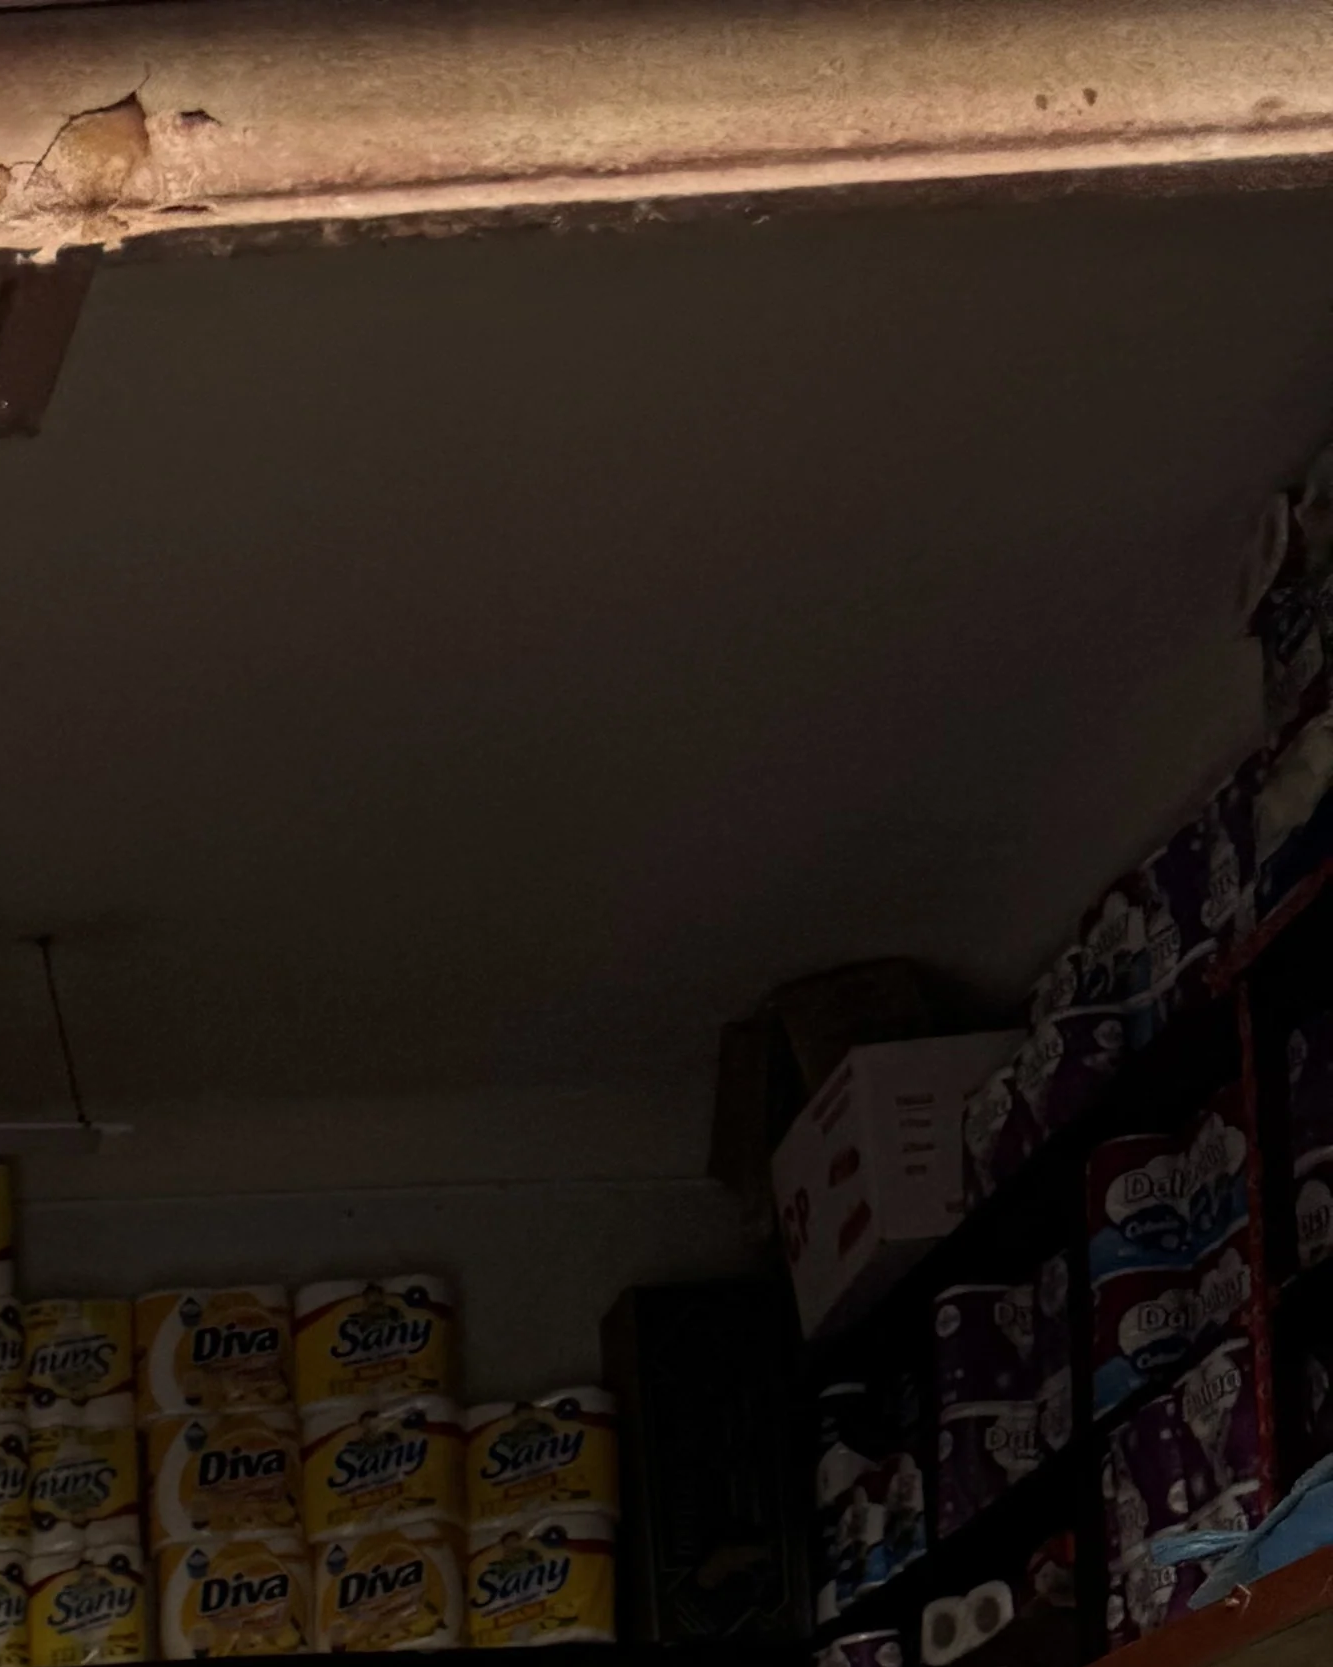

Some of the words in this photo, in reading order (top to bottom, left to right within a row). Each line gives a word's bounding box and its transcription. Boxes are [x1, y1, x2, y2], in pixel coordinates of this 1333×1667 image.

[192, 1323, 280, 1365] Diva
[329, 1316, 432, 1360] Sany
[198, 1444, 287, 1487] Diva
[327, 1437, 429, 1488] Sany
[480, 1426, 586, 1480] Sany
[199, 1571, 291, 1614] Diva
[337, 1558, 425, 1609] Diva
[471, 1554, 571, 1609] Sany
[46, 1582, 137, 1630] Sany
